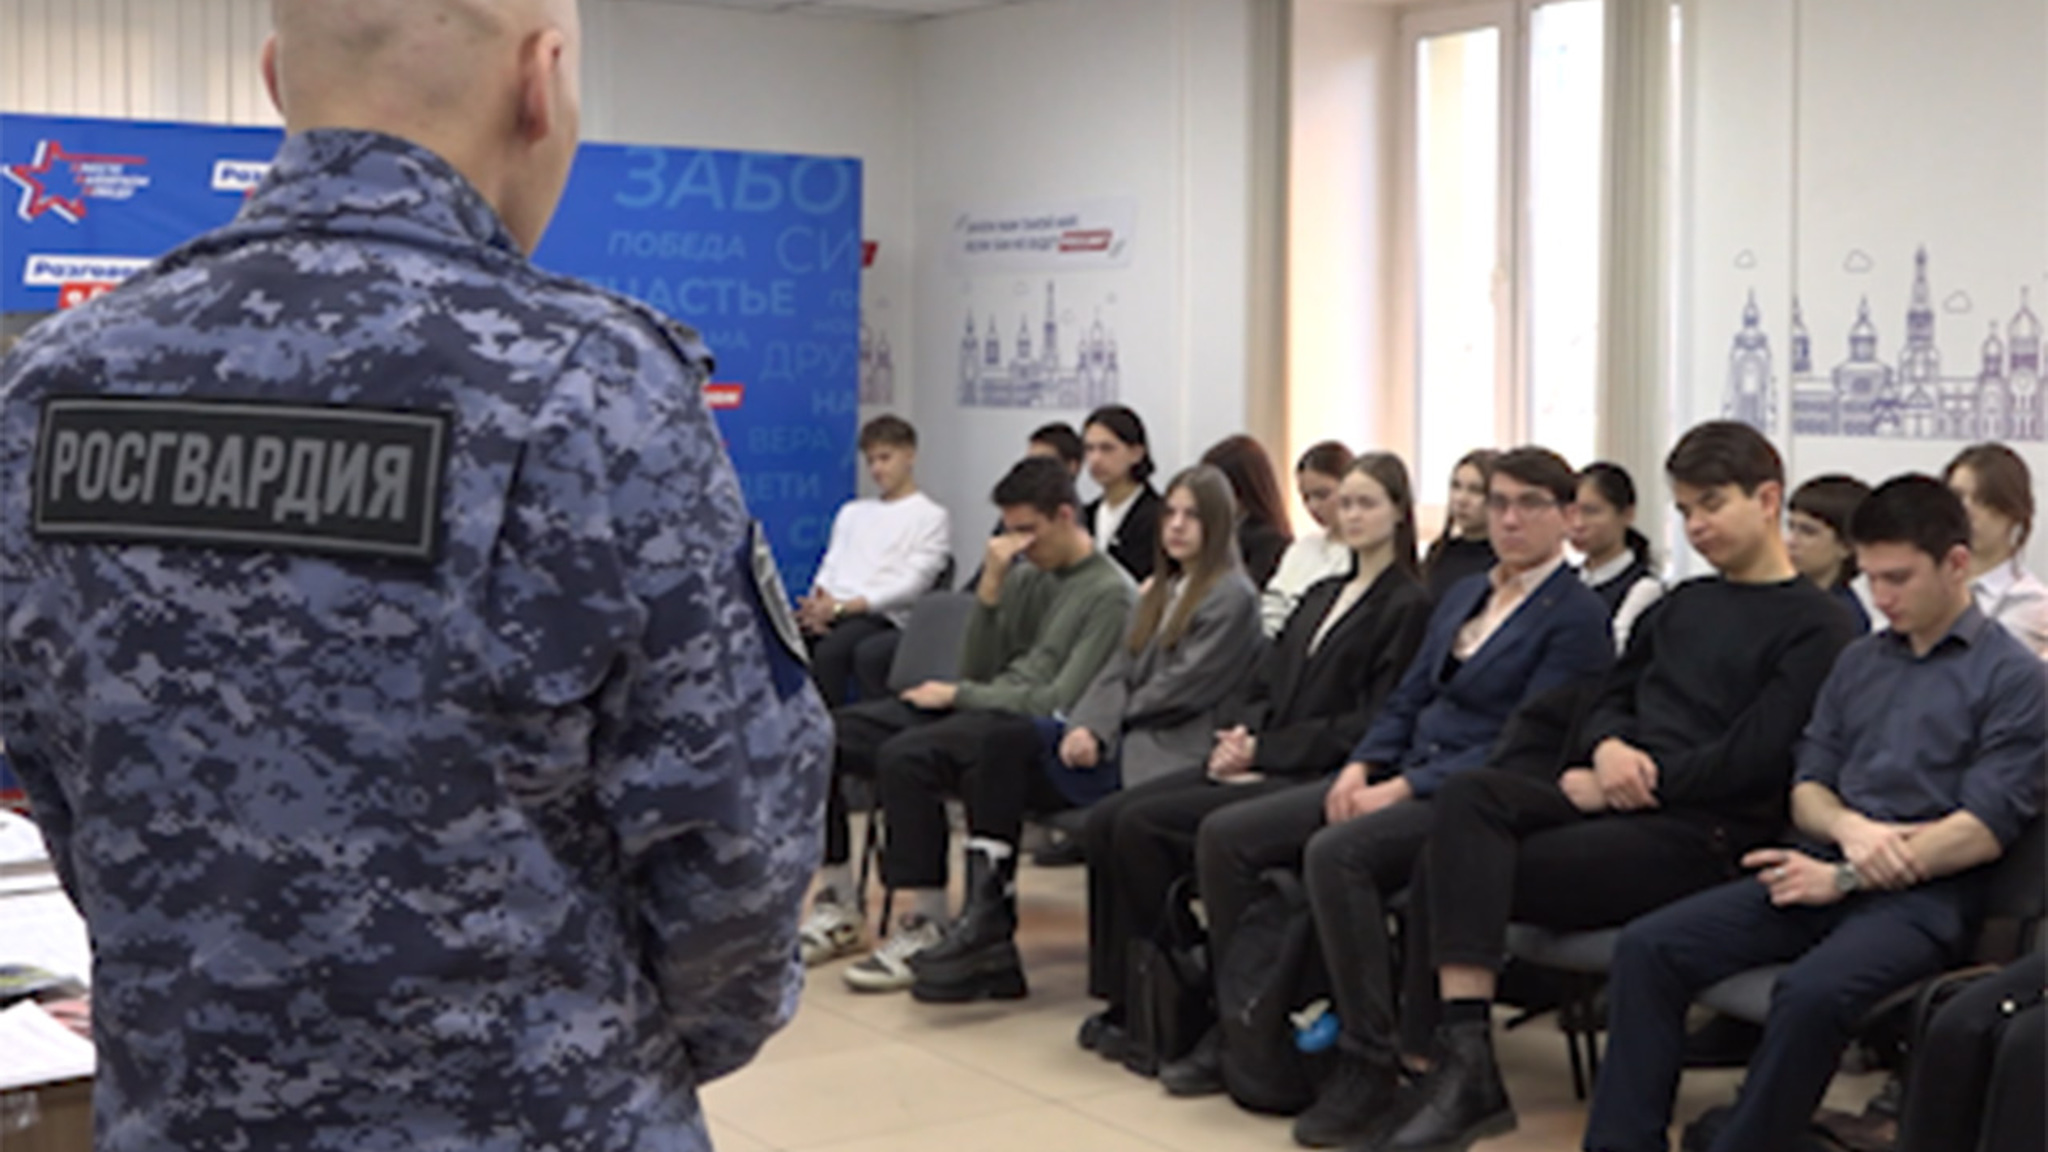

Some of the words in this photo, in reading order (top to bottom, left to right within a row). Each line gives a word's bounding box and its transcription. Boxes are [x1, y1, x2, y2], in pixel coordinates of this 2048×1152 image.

[613, 147, 850, 215] ЗАБО
[607, 230, 746, 262] ПОБЕДА
[750, 425, 833, 455] ВЕРА
[49, 429, 414, 525] РОСГВАРДИЯ
